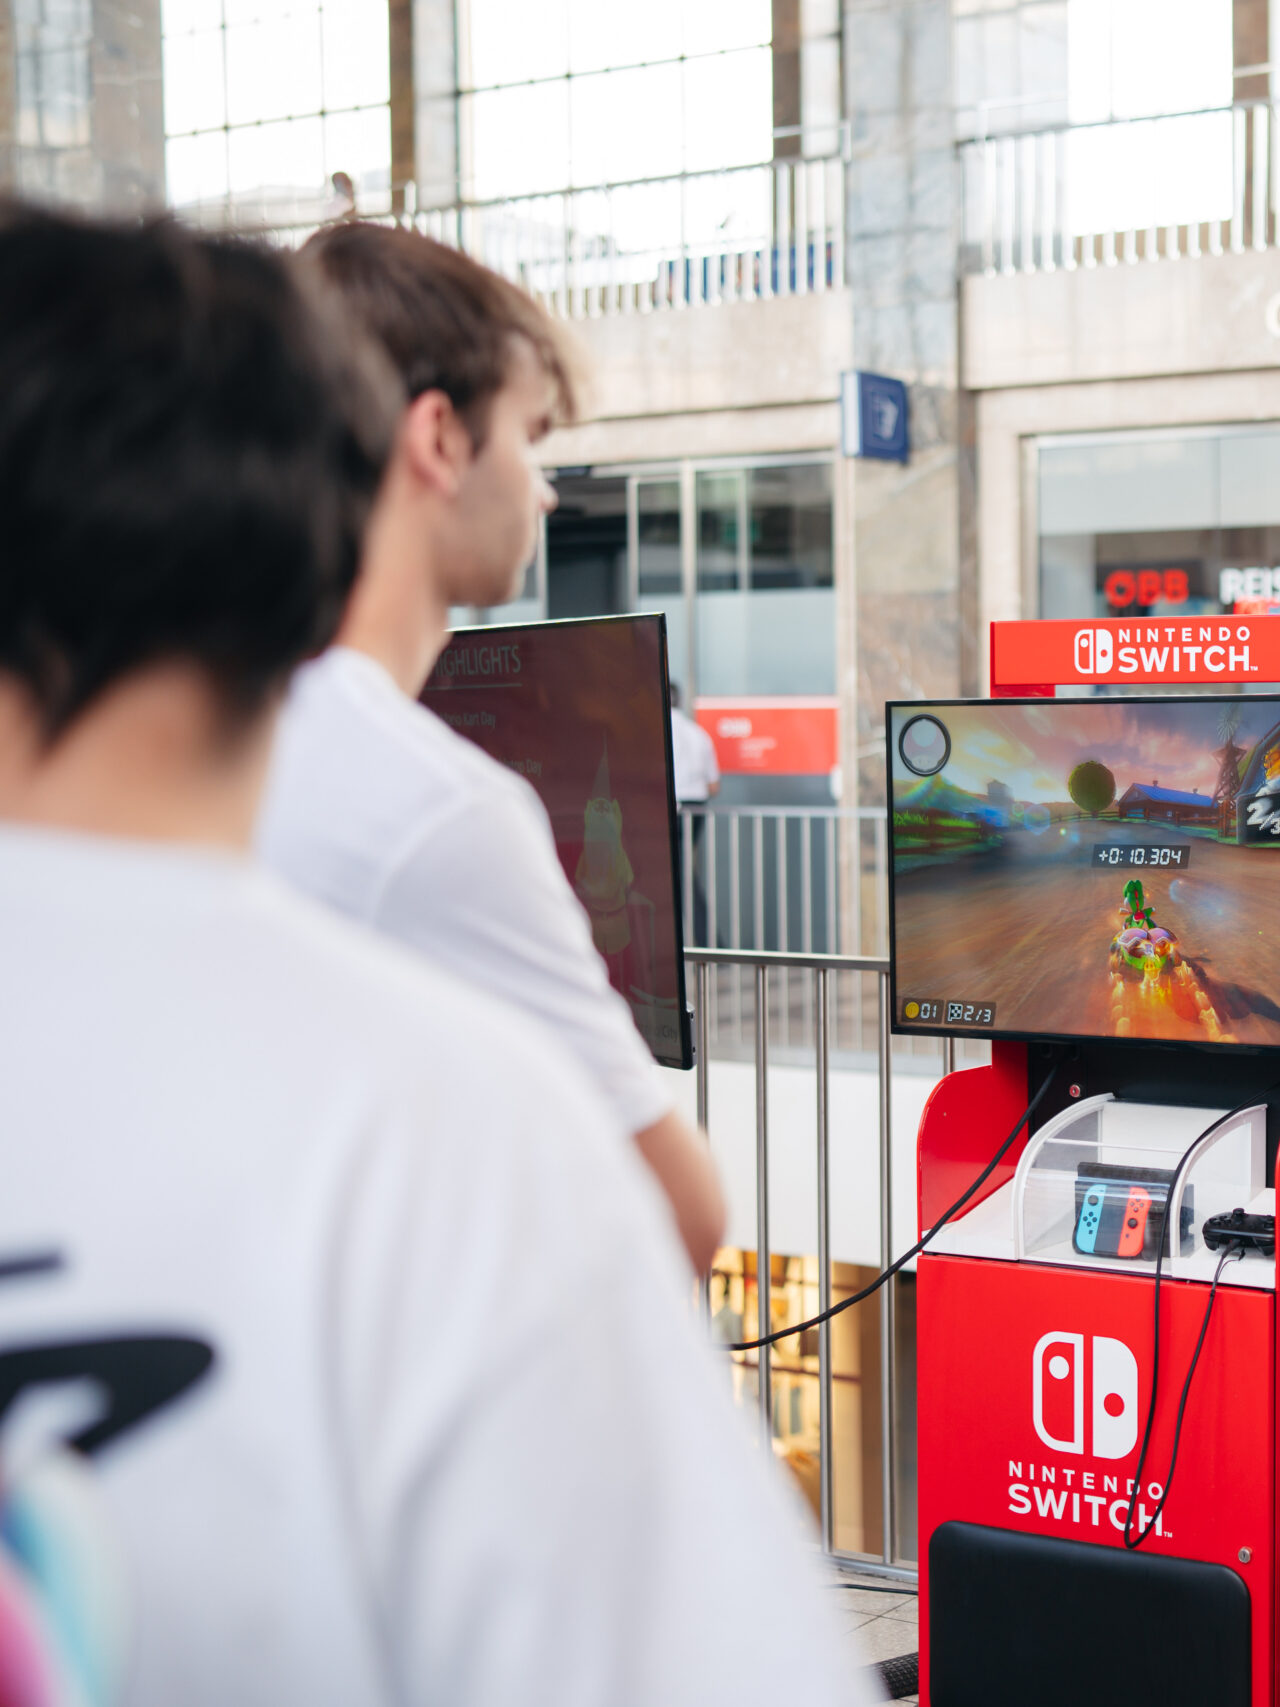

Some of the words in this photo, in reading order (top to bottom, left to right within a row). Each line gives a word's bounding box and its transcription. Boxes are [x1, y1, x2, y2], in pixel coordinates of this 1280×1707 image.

[1118, 626, 1250, 643] NINTENDO
[964, 1005, 991, 1023] 2/3
[1009, 1460, 1164, 1500] NINTENDO
